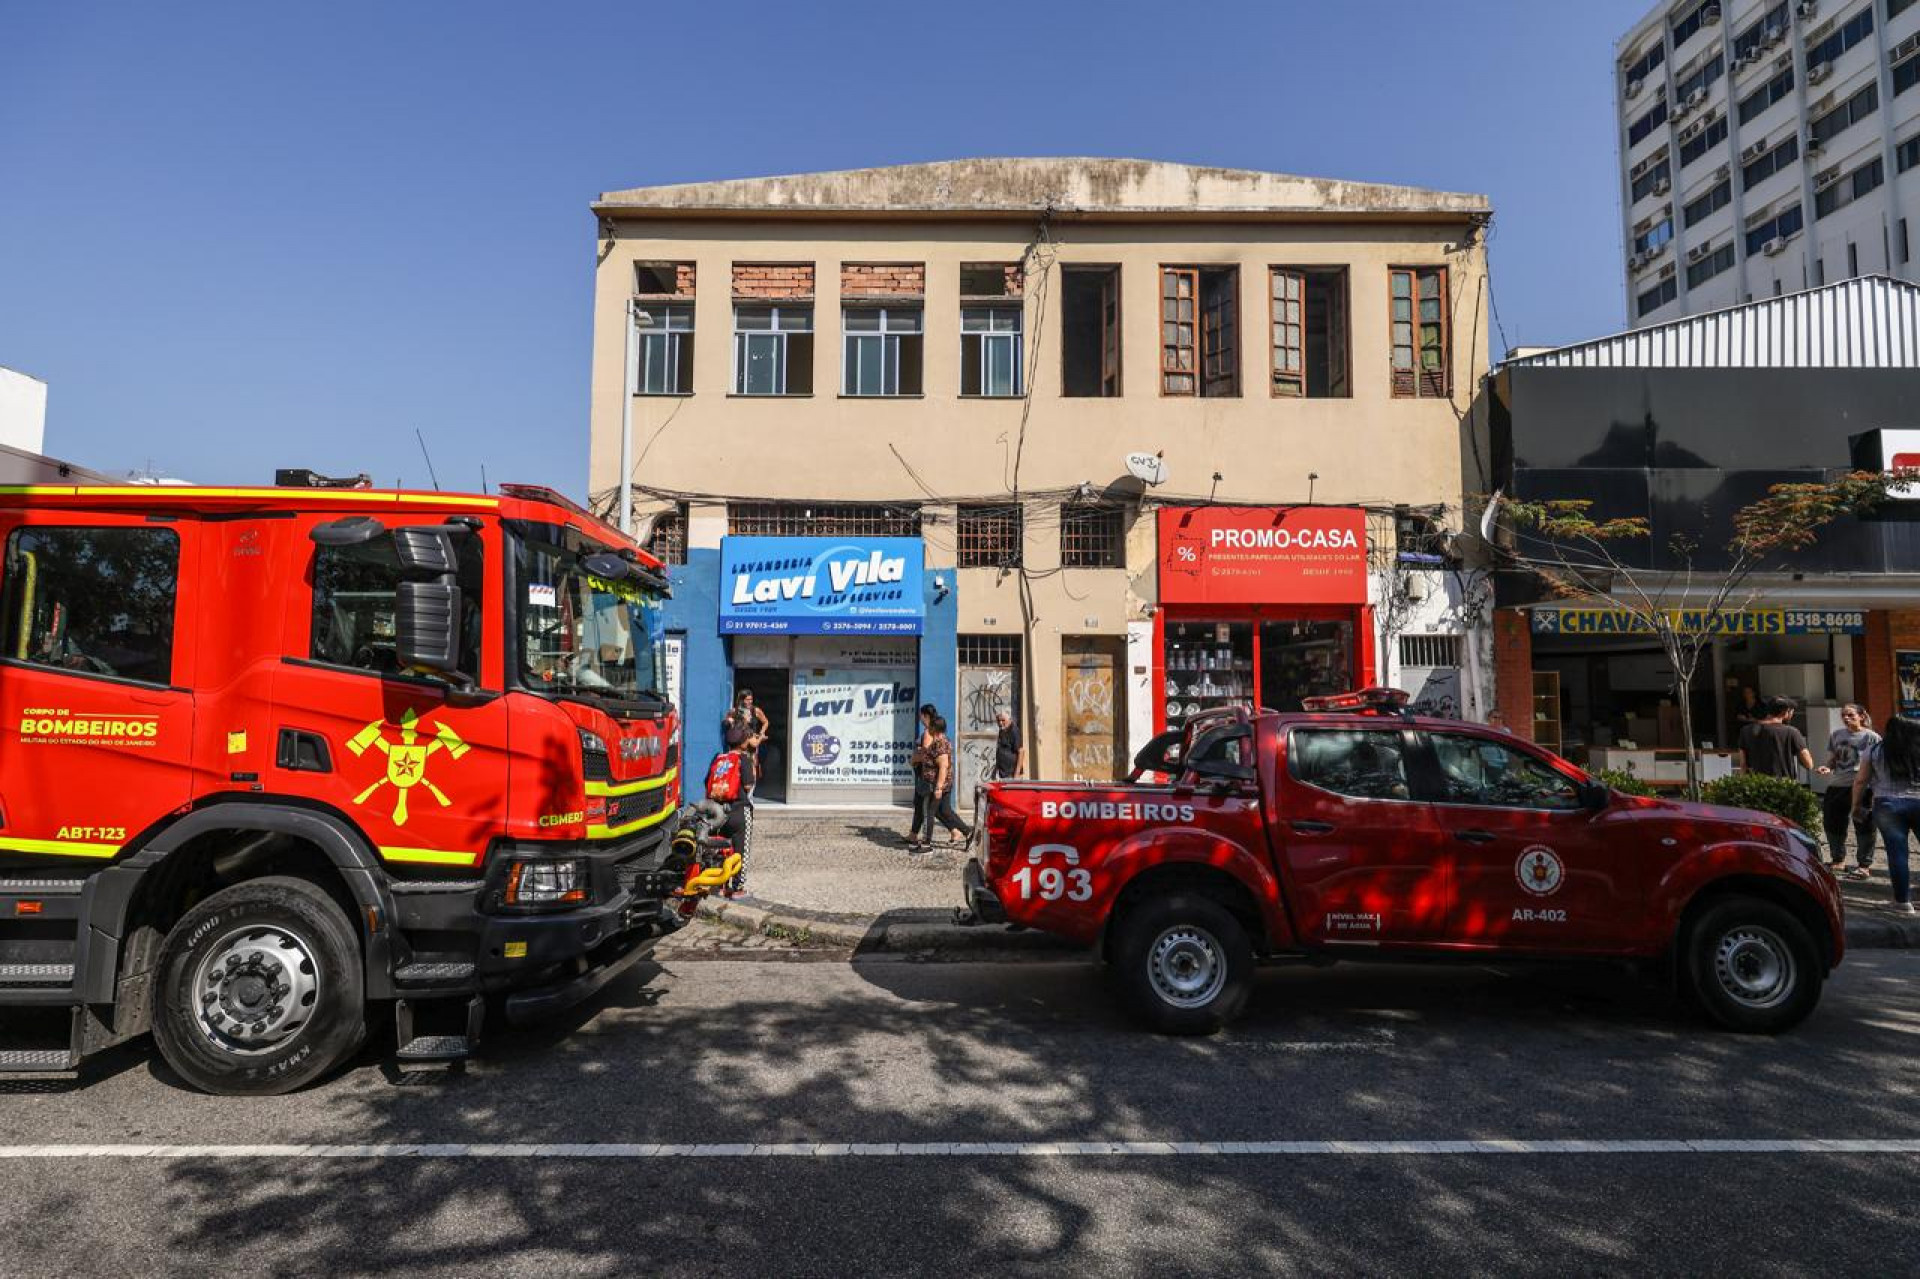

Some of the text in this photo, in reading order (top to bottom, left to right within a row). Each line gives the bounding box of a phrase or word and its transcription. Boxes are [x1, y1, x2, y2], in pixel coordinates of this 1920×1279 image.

[1211, 529, 1357, 548] PROMO-CASA
[732, 558, 813, 574] LAVANDERIA
[829, 551, 905, 592] Vila
[850, 590, 903, 602] SERVICE
[1562, 611, 1667, 631] CHAVA
[1787, 613, 1863, 626] 3518-8628
[798, 686, 852, 696] LAVANDERIA
[56, 708, 70, 716] DE
[20, 719, 158, 737] BOMBEIROS
[849, 741, 913, 750] 2576-5094
[1041, 801, 1195, 821] BOMBEIROS
[57, 826, 126, 840] ABT-123
[1012, 867, 1093, 901] 193
[1512, 909, 1567, 921] AR-402
